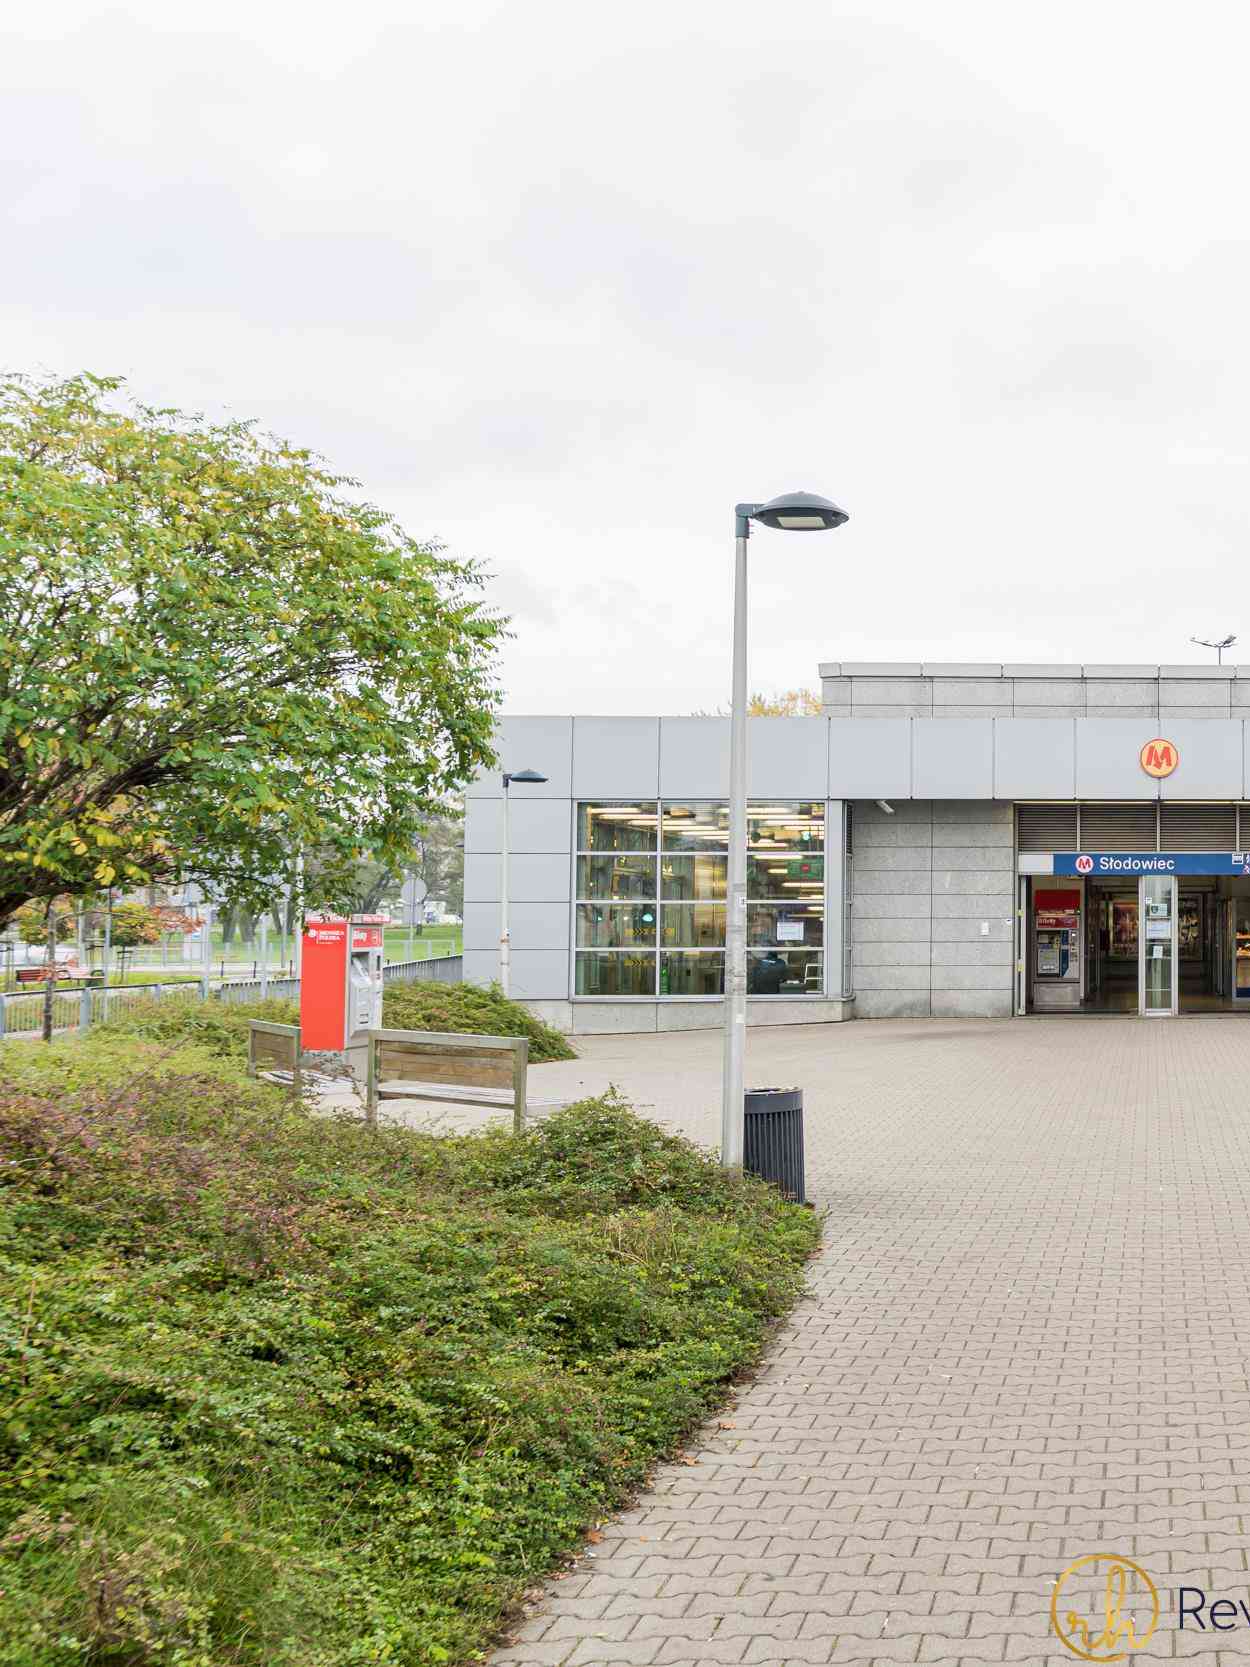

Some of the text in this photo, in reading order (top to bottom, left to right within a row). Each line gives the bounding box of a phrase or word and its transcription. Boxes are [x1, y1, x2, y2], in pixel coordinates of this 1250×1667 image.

[1145, 744, 1172, 769] M
[1078, 857, 1175, 870] M Słodowiec
